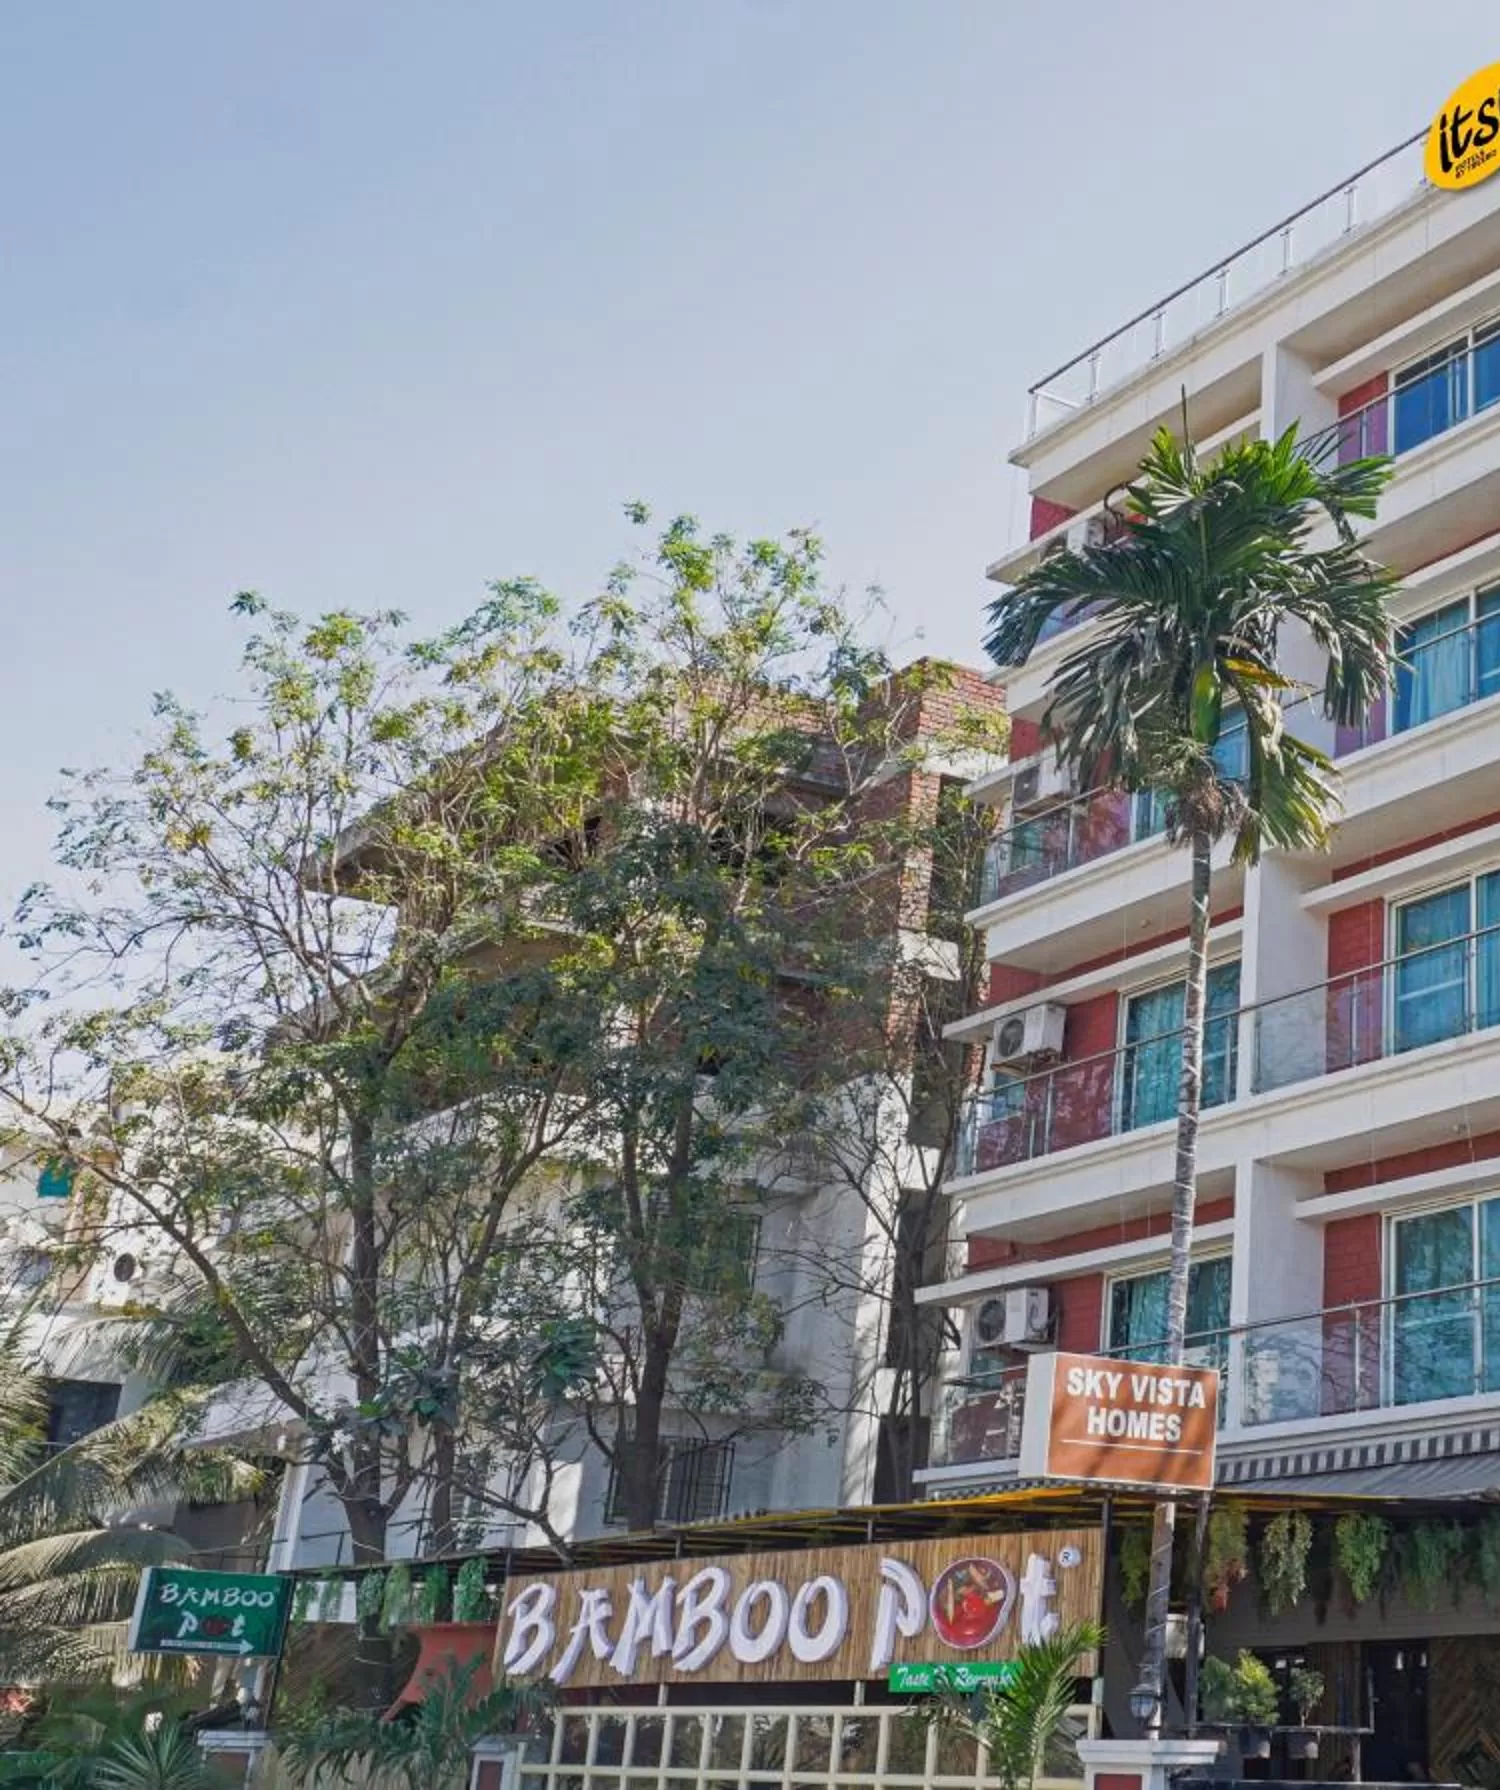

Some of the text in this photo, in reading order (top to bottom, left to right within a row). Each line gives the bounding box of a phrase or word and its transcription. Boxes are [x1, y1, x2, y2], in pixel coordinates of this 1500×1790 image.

[1067, 1367, 1206, 1409] SKY VISTA
[1087, 1405, 1182, 1443] HOMES
[159, 1582, 275, 1608] BAMBOO
[503, 1566, 849, 1685] BAMBOO
